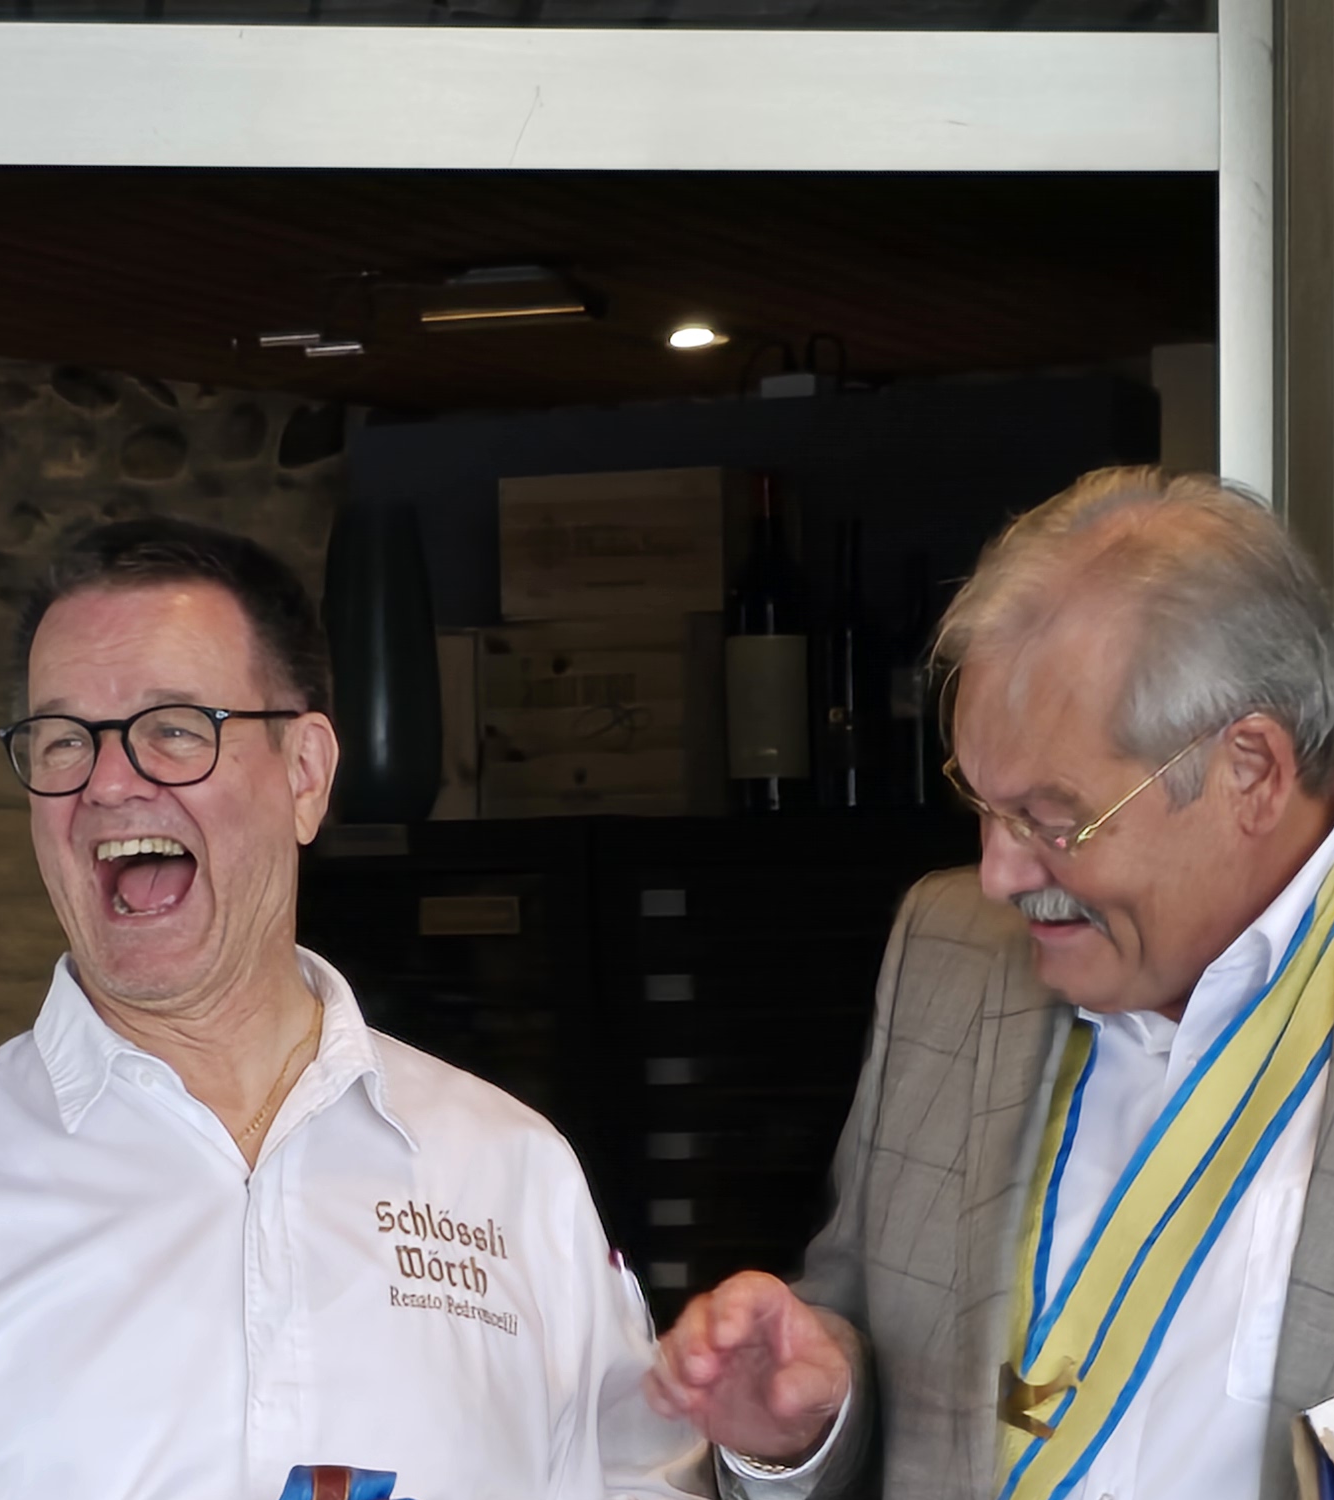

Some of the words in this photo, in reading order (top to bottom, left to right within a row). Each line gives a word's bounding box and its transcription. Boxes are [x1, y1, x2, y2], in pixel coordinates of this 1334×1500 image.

[375, 1200, 508, 1260] Schlössli
[389, 1285, 443, 1309] Renato
[395, 1245, 488, 1298] Wörth
